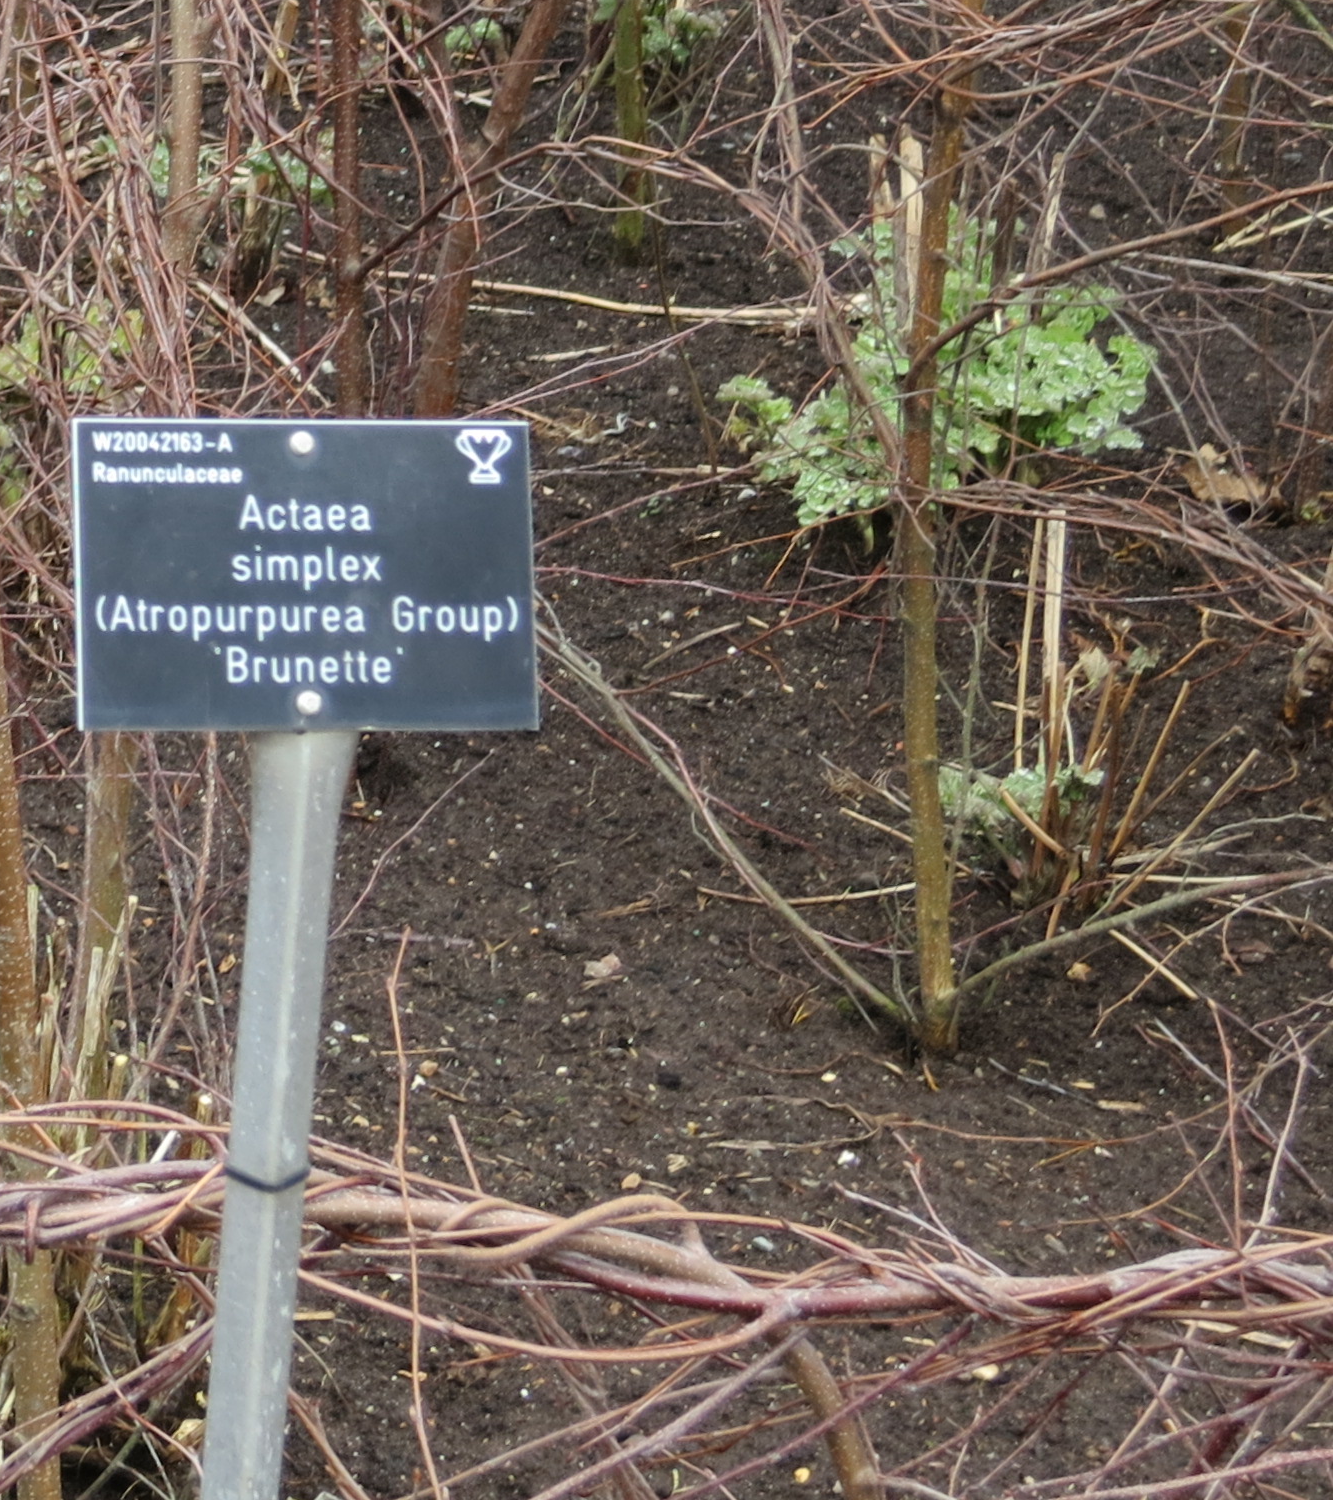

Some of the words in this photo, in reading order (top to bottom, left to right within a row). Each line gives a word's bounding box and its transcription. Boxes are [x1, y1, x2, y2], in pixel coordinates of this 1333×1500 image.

[92, 431, 233, 453] W20042163-A
[92, 462, 243, 484] Ranunculaceae
[239, 495, 371, 532] Actaea
[232, 546, 382, 590] simplex
[95, 596, 365, 640] (Atropurpurea
[392, 596, 520, 641] Group)
